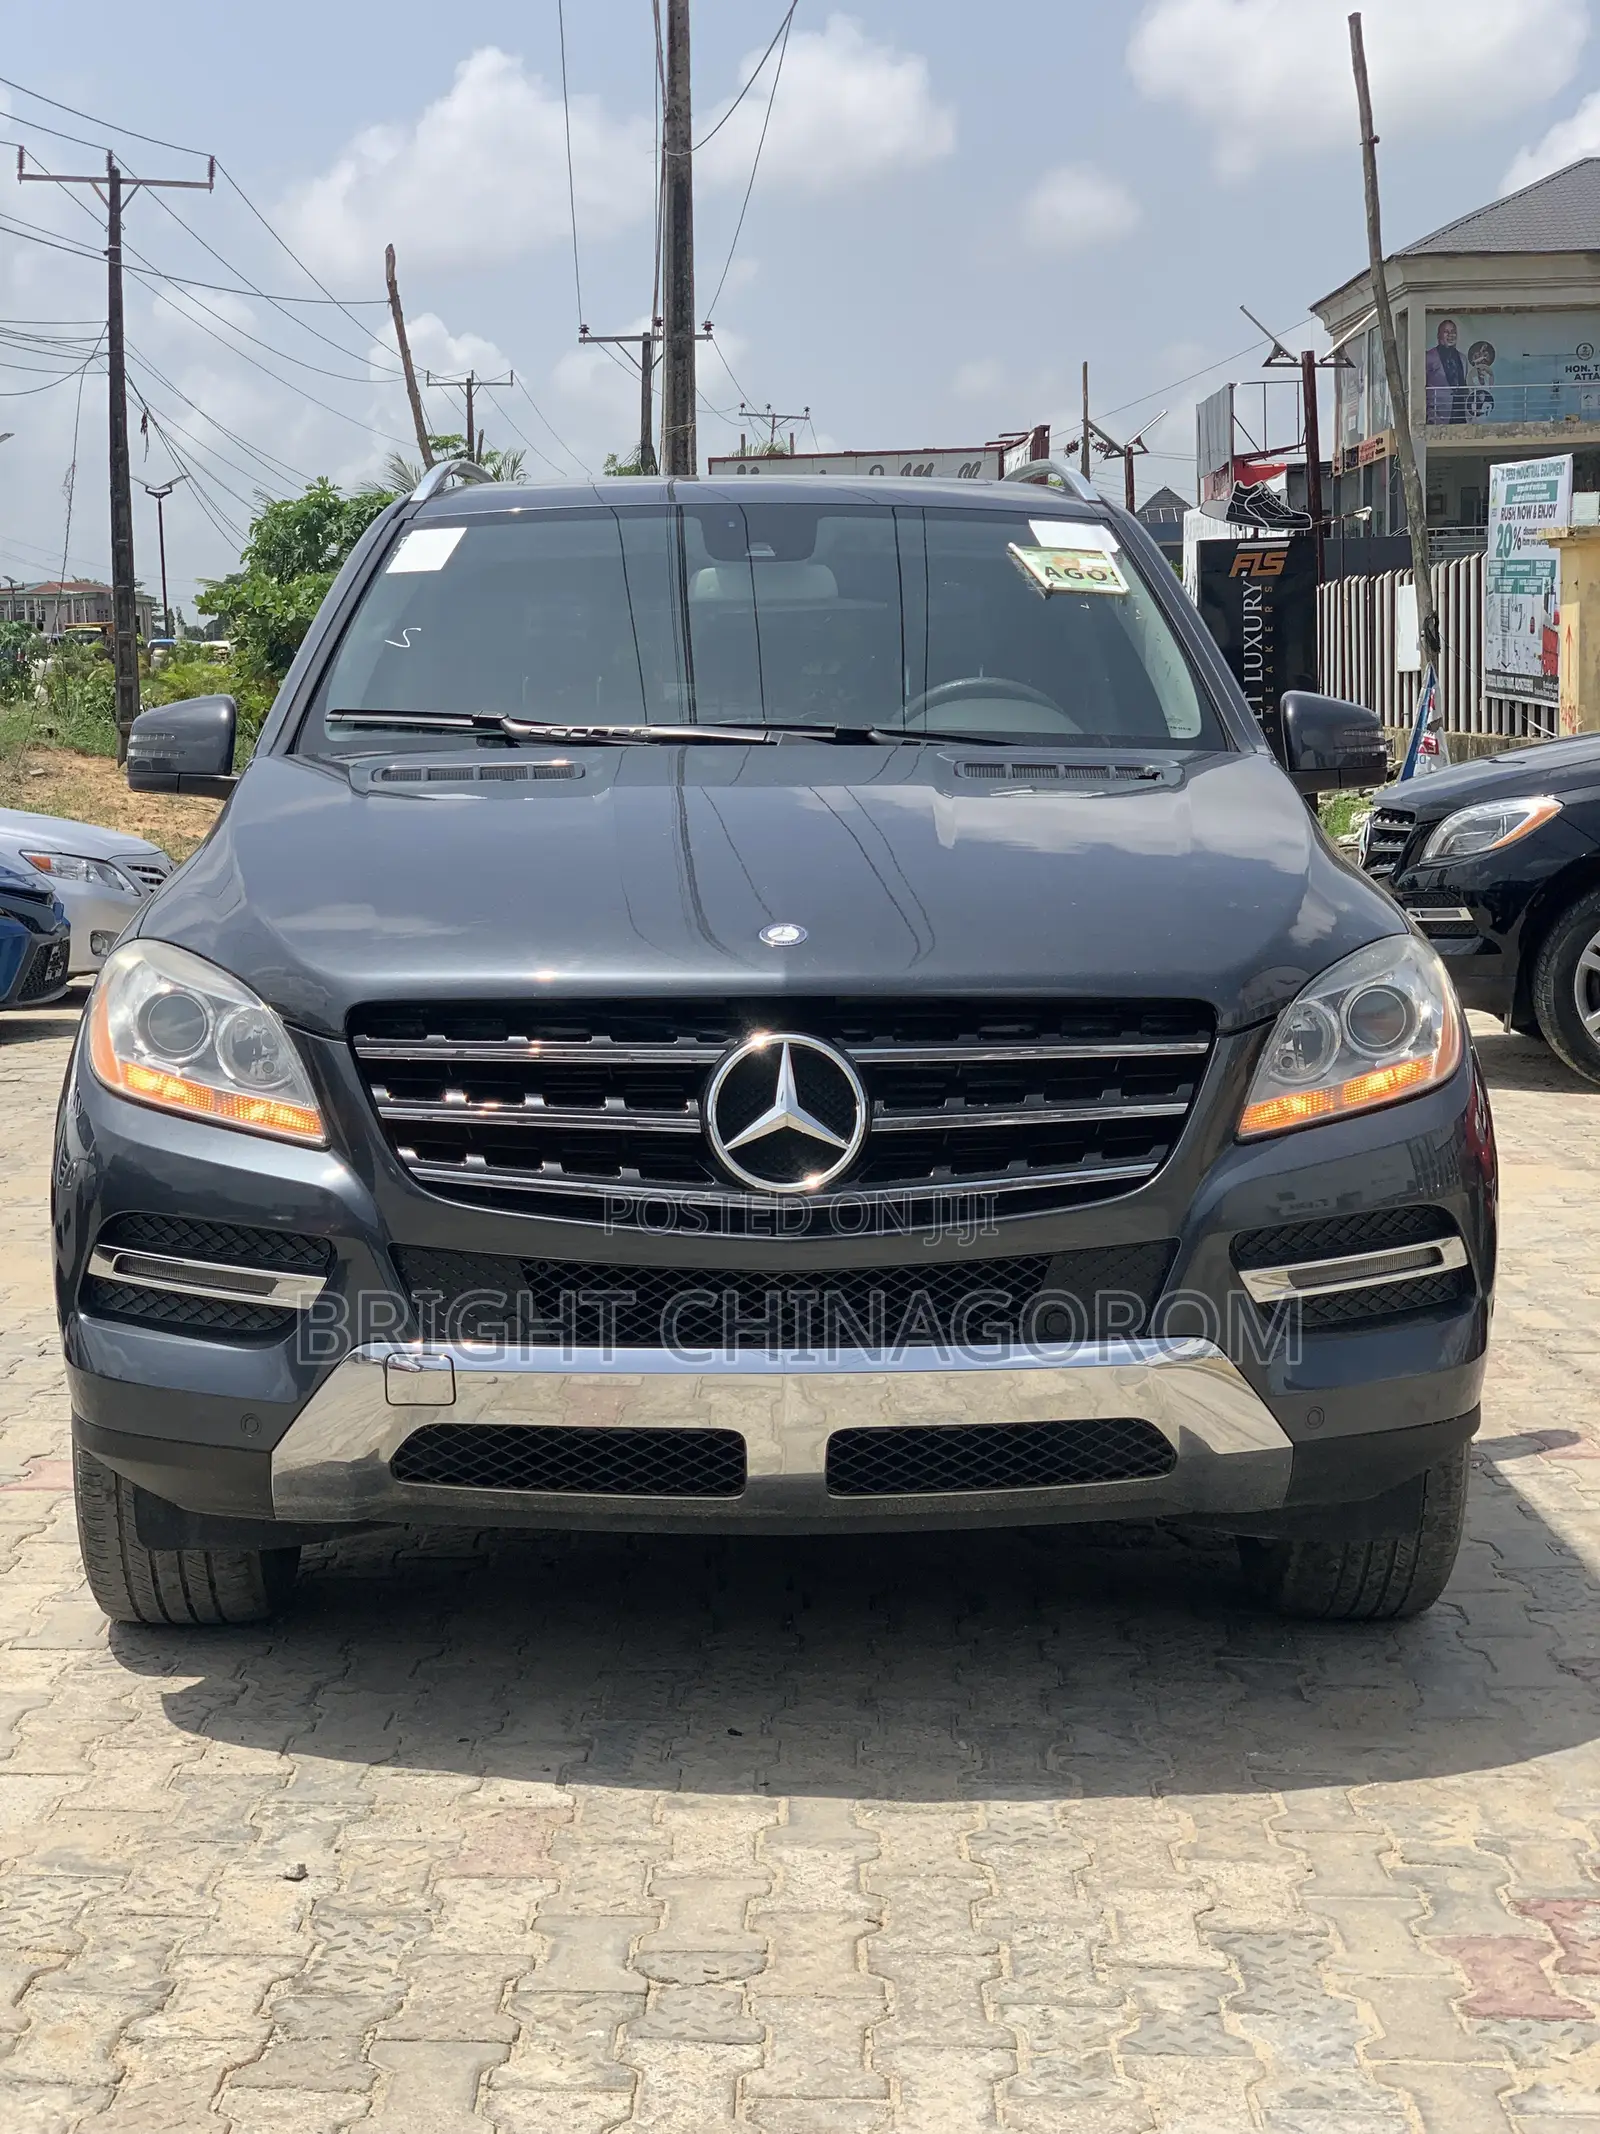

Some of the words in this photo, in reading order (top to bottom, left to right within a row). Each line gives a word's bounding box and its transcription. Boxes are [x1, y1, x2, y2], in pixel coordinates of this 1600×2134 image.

[1565, 364, 1591, 373] HON.
[1500, 506, 1516, 521] RUSH
[1517, 505, 1532, 520] NOW
[1537, 503, 1558, 518] ENJOY
[1243, 581, 1264, 682] LUXURY
[1265, 586, 1275, 733] SNEAKERS
